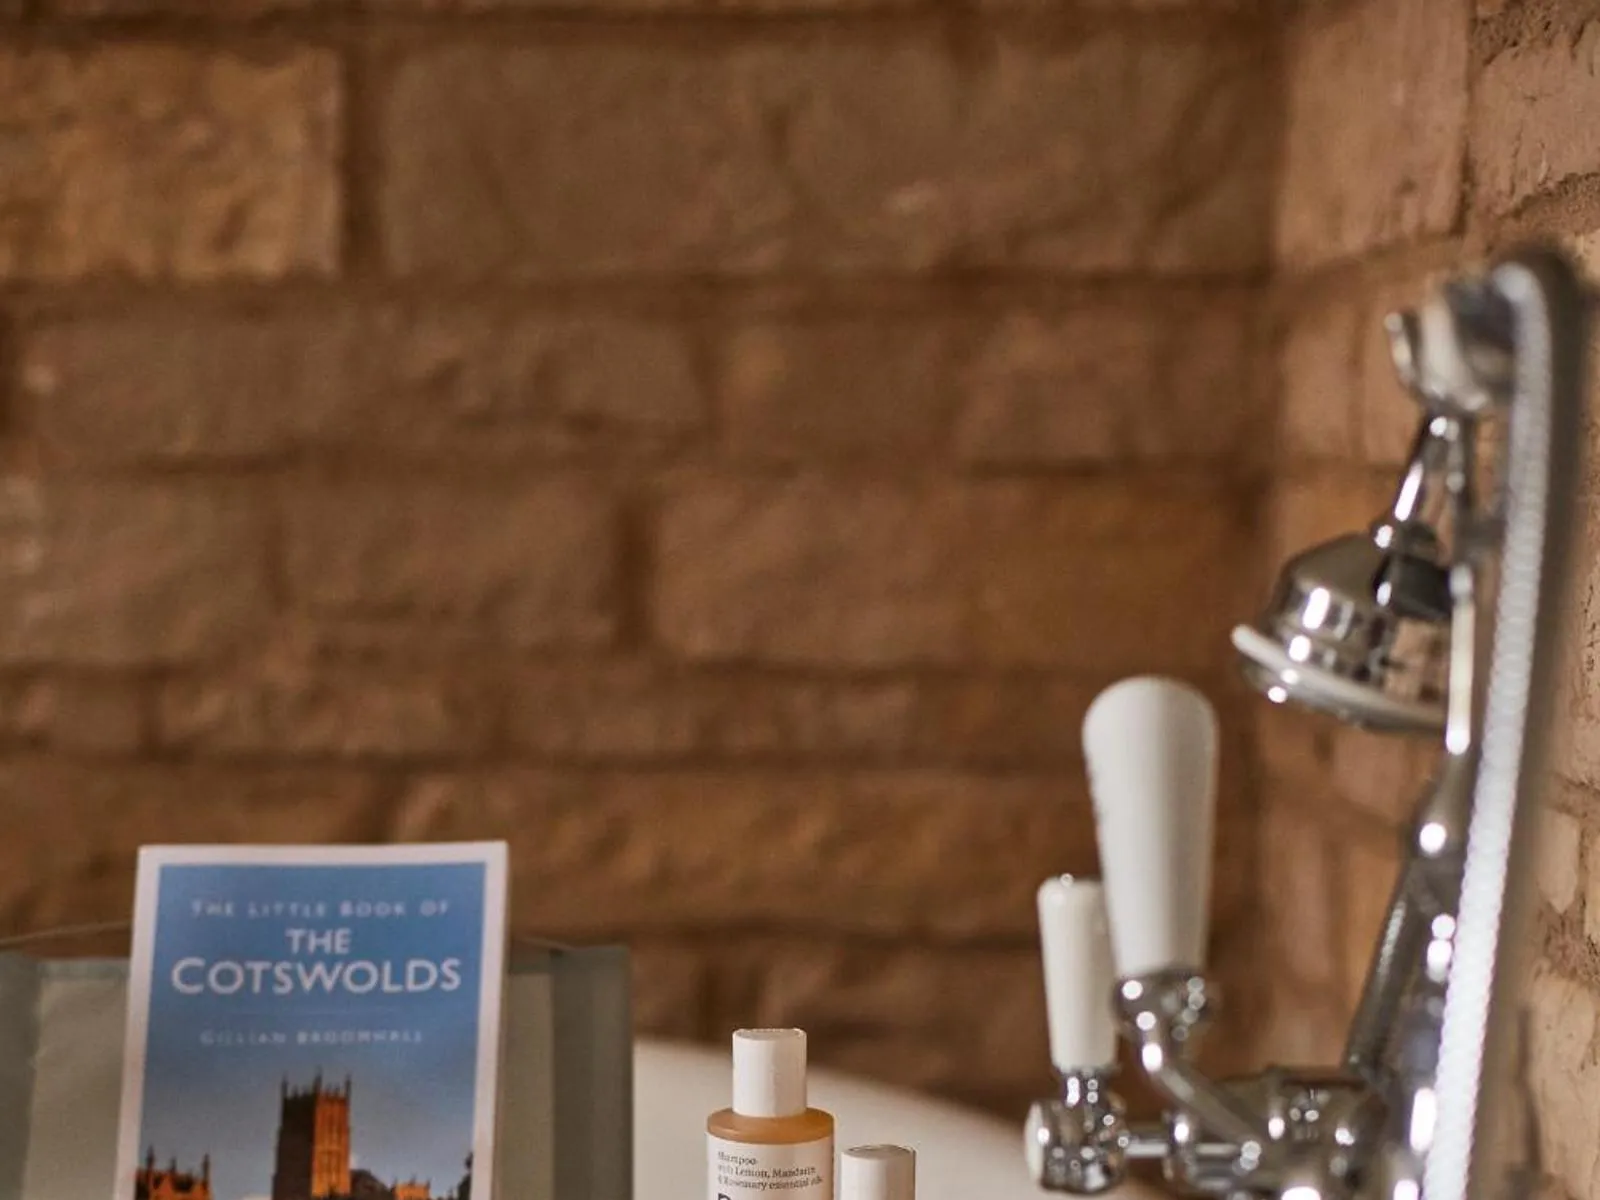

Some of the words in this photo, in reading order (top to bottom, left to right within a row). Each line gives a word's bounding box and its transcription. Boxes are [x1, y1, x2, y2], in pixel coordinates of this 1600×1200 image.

[338, 900, 407, 918] BOOK
[285, 928, 353, 955] THE
[171, 957, 463, 995] COTSWOLDS
